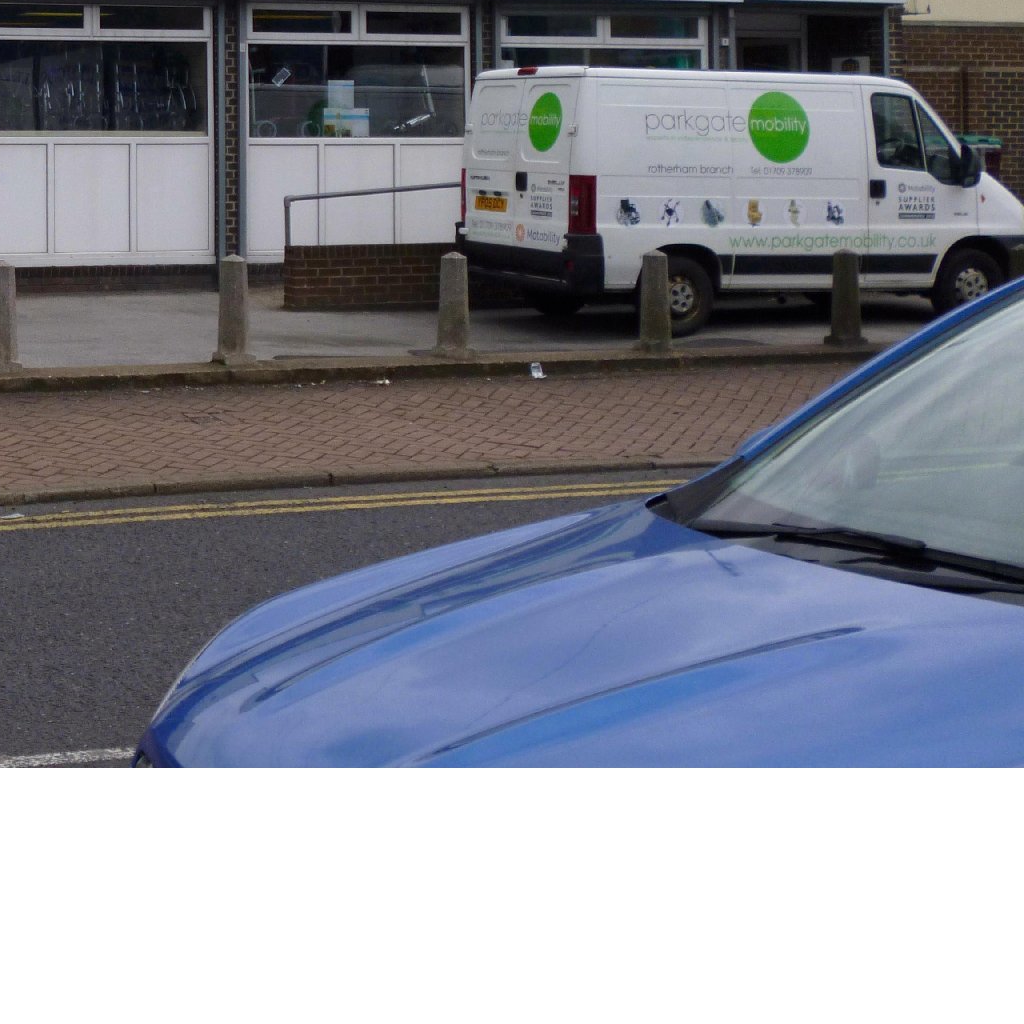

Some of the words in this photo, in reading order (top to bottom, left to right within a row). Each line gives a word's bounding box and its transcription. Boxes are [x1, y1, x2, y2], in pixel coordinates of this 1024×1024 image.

[645, 109, 746, 136] parkgate
[750, 116, 807, 134] mobility
[647, 163, 698, 175] rotherham
[699, 163, 734, 175] branch
[898, 203, 936, 211] AWARDS
[526, 228, 560, 246] Motability
[729, 233, 936, 251] www.parkgatemobility.co.uk
